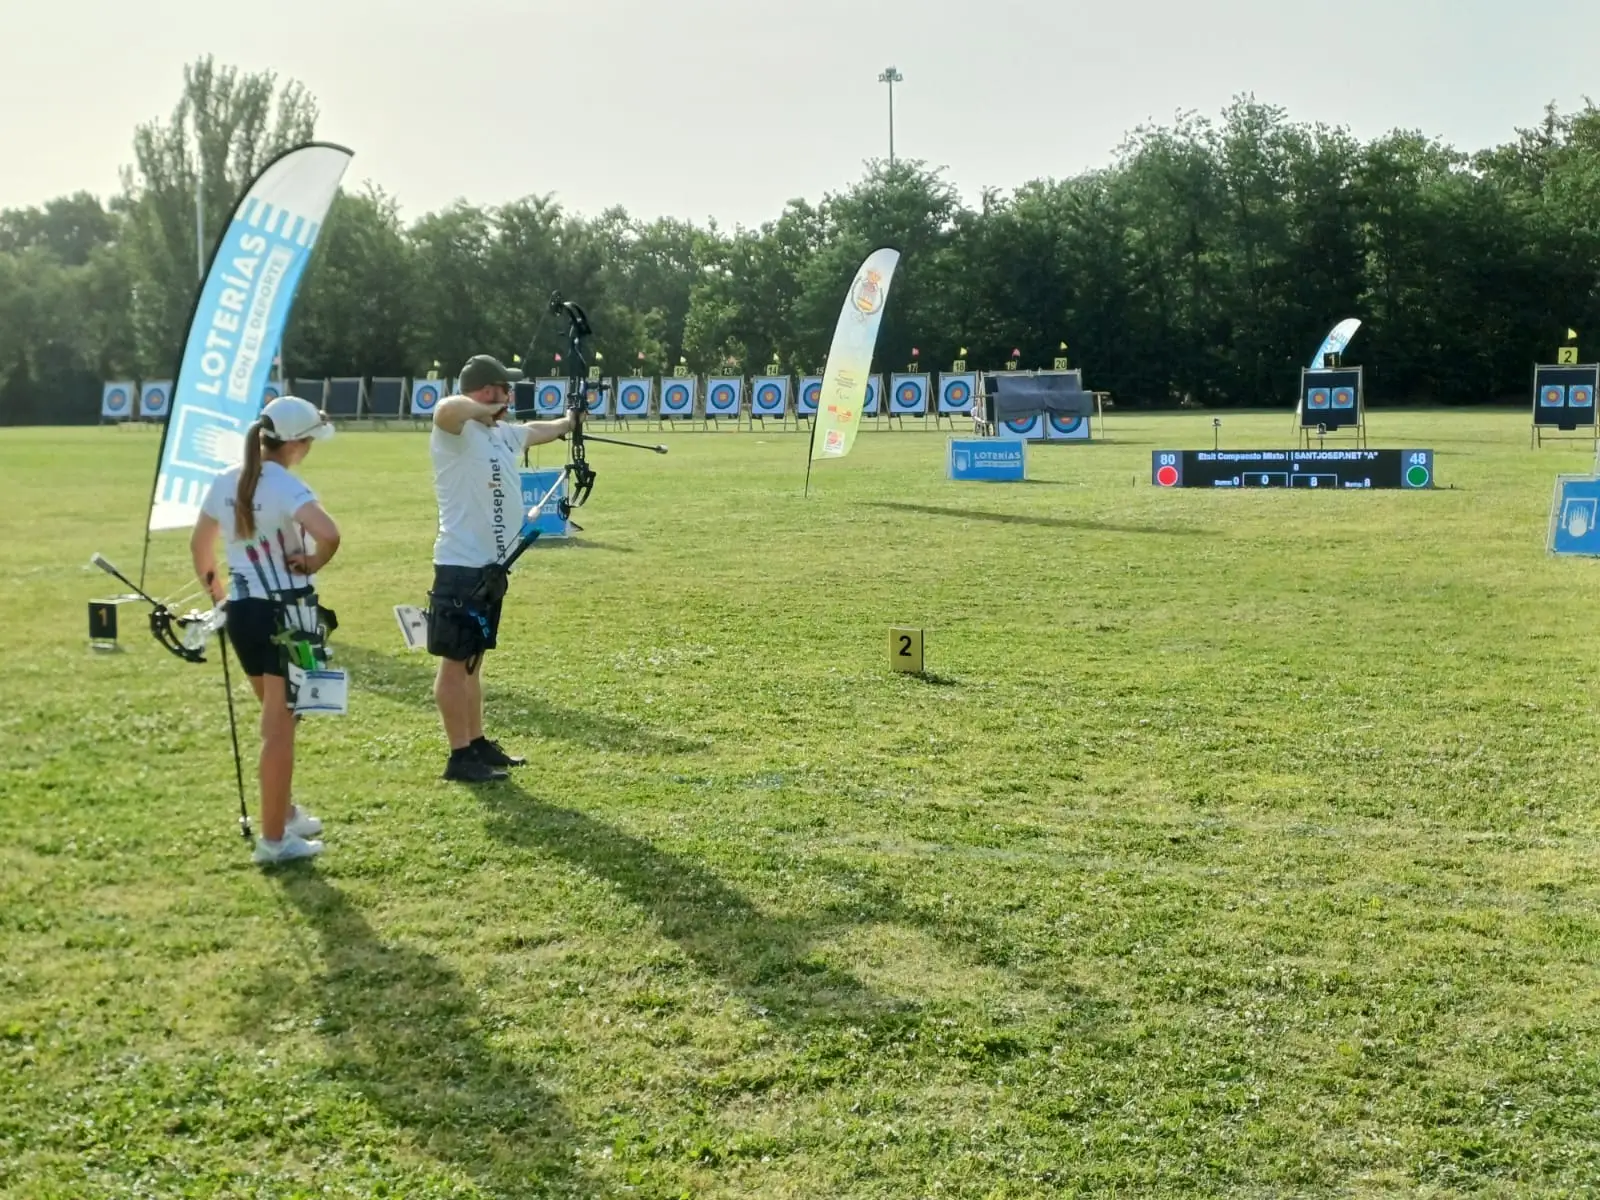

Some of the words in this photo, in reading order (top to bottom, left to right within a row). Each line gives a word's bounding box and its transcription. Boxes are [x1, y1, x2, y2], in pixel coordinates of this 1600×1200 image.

[250, 258, 284, 329] DEPORTE
[196, 233, 266, 395] LOTERÍAS
[246, 334, 259, 351] EL
[1328, 354, 1335, 368] 1
[1564, 350, 1573, 363] 2
[1005, 360, 1017, 370] 19
[1055, 359, 1066, 369] 20
[233, 354, 253, 389] CON
[676, 367, 685, 376] 12
[1160, 454, 1175, 465] 80
[1410, 452, 1426, 465] 48
[1233, 476, 1240, 485] 0
[1262, 475, 1269, 485] 0
[1310, 476, 1318, 486] 8
[490, 457, 506, 559] santjosep.net
[99, 608, 107, 627] 1
[899, 635, 912, 656] 2
